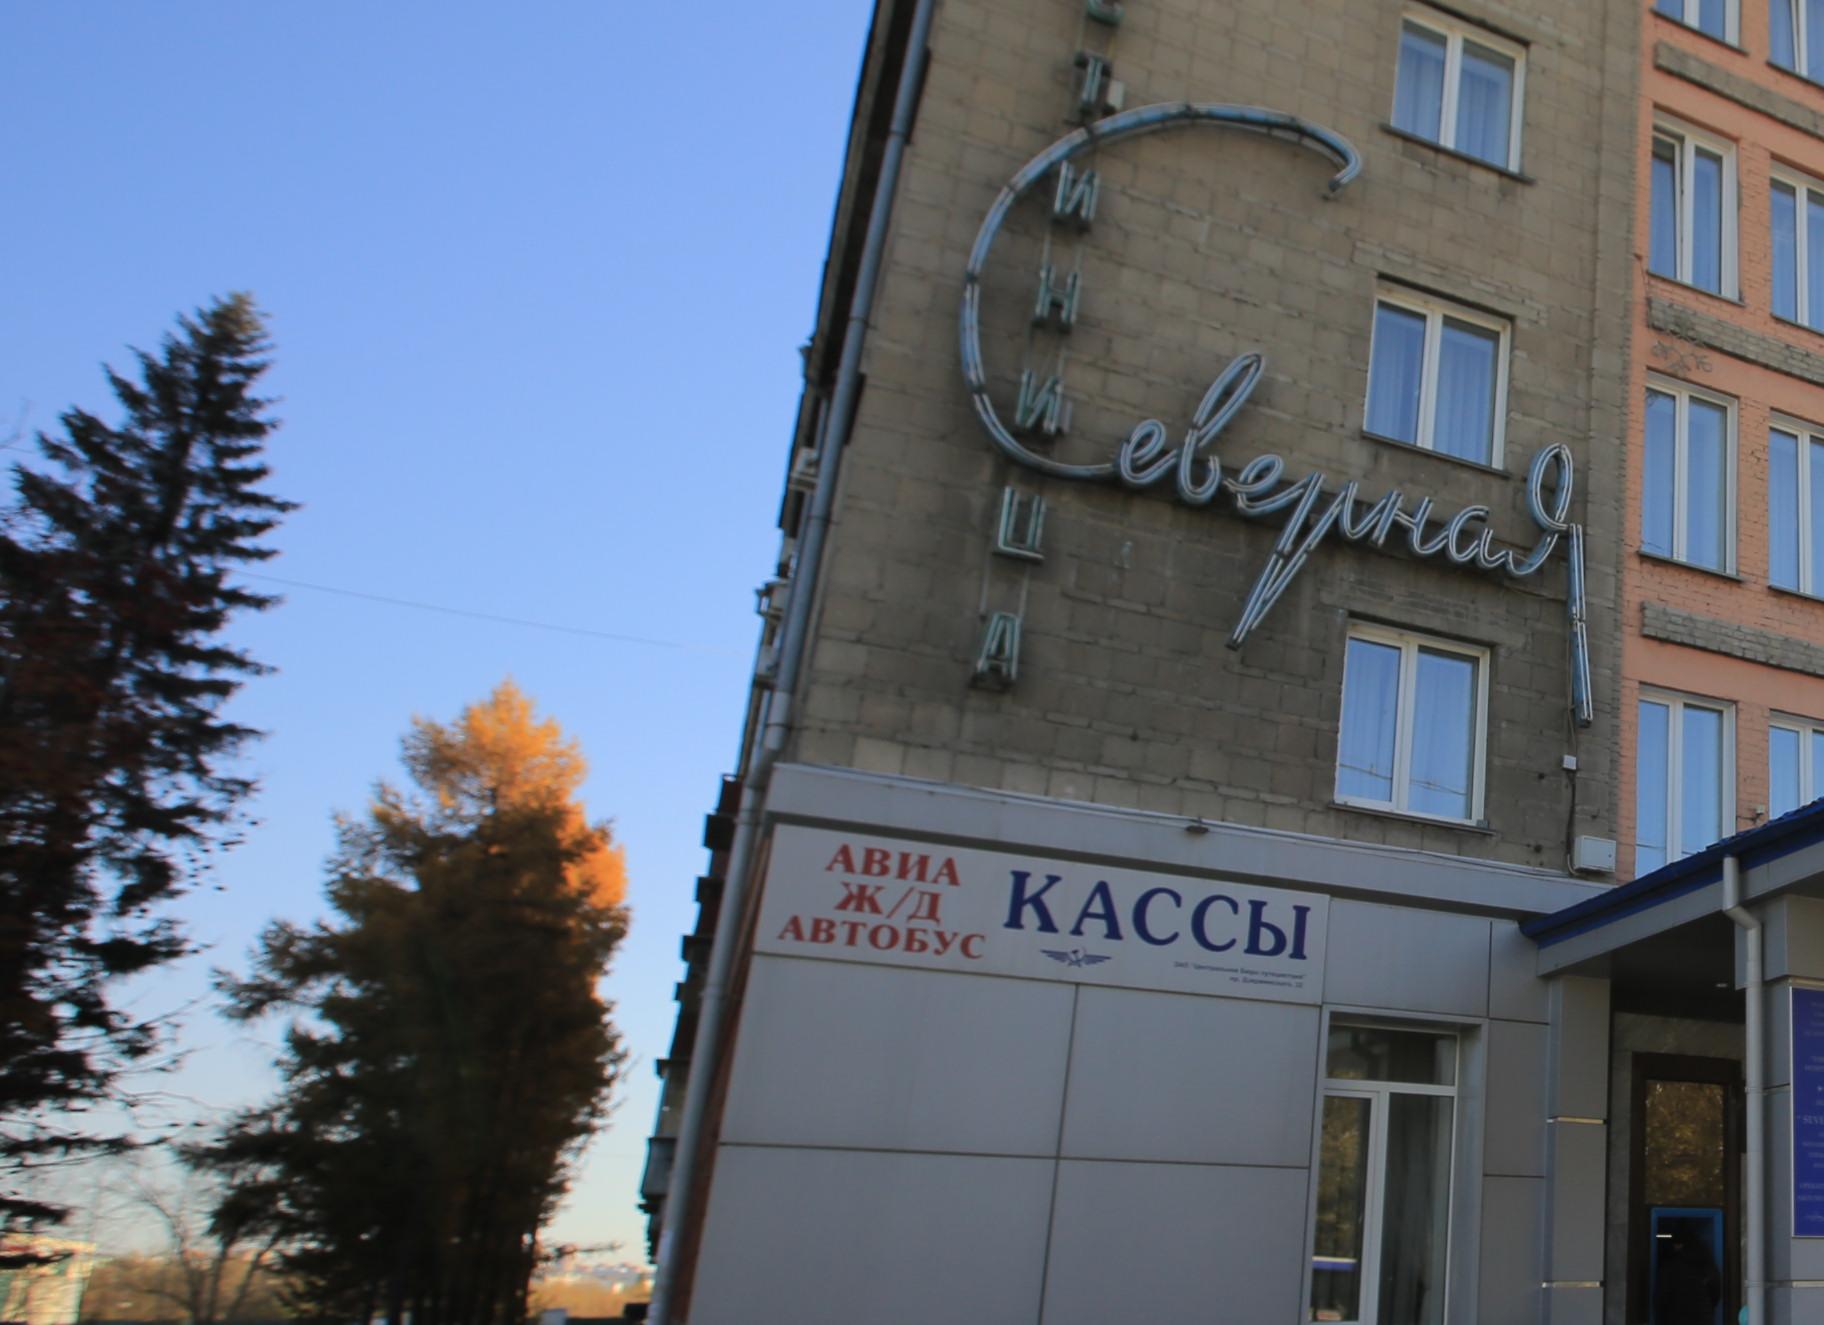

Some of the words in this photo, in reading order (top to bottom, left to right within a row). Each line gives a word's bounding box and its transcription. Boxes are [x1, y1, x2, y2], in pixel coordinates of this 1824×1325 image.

[824, 843, 961, 886] АВИА
[834, 881, 943, 926] Ж/Д
[1003, 870, 1311, 960] КАССЫ
[777, 915, 987, 960] АВТОБУС
